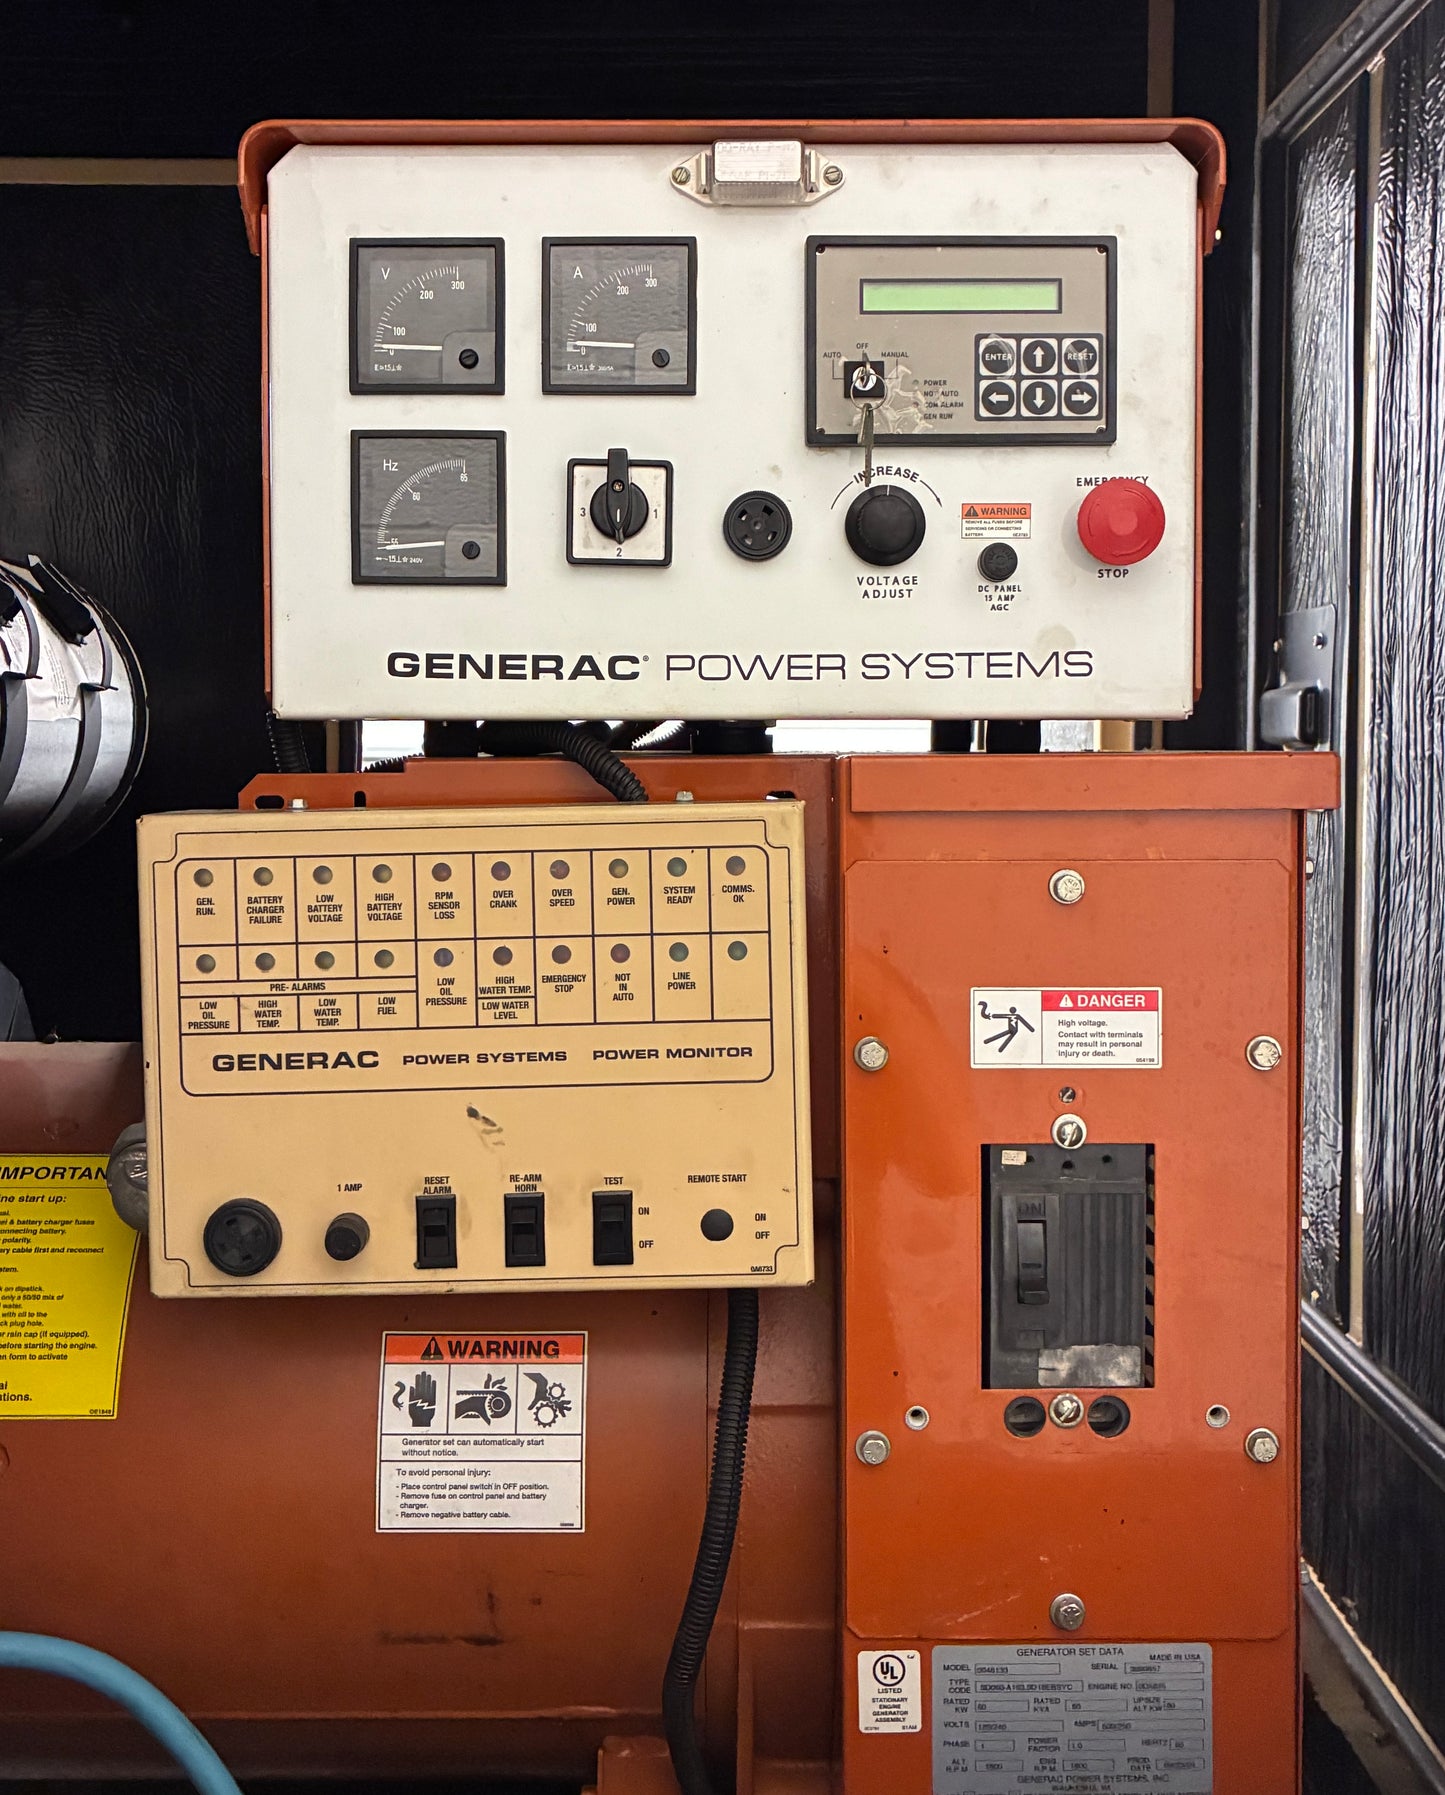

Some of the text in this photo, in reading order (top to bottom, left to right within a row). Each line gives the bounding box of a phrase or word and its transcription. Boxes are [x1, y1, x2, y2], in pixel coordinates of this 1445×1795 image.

[382, 268, 390, 280] V
[574, 266, 583, 278] A
[451, 281, 465, 290] 300
[645, 279, 658, 287] 300
[617, 286, 629, 295] 200
[420, 291, 434, 299] 200
[394, 327, 406, 336] 100
[586, 323, 597, 332] 100
[581, 347, 585, 355] 0
[384, 459, 398, 471] Hz
[461, 473, 468, 482] 65
[854, 466, 919, 484] INCREASE
[1077, 476, 1149, 486] EMERY
[413, 492, 421, 501] 60
[580, 508, 586, 517] 3
[654, 509, 658, 518] 1
[617, 548, 622, 557] 2
[1098, 569, 1129, 578] STOP
[857, 576, 918, 586] VOLTAGE
[862, 589, 913, 599] ADJUST
[666, 653, 846, 680] POWER
[861, 650, 1094, 680] SYSTEMS
[552, 889, 573, 897] OVER
[612, 888, 630, 896] GEN.
[664, 886, 695, 894] SYSTEM
[722, 885, 755, 893] COMMS.
[375, 893, 394, 901] HIGH
[435, 892, 453, 900] RPM
[493, 890, 514, 898] OVER
[197, 898, 215, 906] GEN.
[248, 896, 283, 904] BATTERY
[316, 895, 334, 903] LOW
[550, 899, 575, 907] SPEED
[607, 897, 636, 906] POWER
[667, 896, 693, 904] READY
[733, 895, 744, 903] OK
[367, 903, 403, 912] BATTERY
[428, 901, 460, 910] SENSOR
[490, 900, 517, 908] CRANK
[196, 908, 215, 916] RUN.
[247, 906, 284, 914] CHARGER
[308, 904, 343, 913] BATTERY
[249, 916, 282, 924] FAILURE
[308, 914, 343, 923] VOLTAGE
[368, 913, 403, 921] VOLTAGE
[496, 976, 515, 984] HIGH
[542, 975, 587, 983] EMERGENCY
[673, 972, 691, 980] LINE
[437, 978, 455, 986] LOW
[668, 982, 696, 990] POWER
[292, 983, 326, 991] ALARMS
[479, 986, 532, 994] WATER TEMP.
[555, 985, 574, 993] STOP
[440, 988, 452, 996] OIL
[378, 997, 396, 1005] LOW
[613, 993, 634, 1001] AUTO
[1078, 995, 1145, 1007] DANGER
[259, 1000, 278, 1008] HIGH
[319, 999, 336, 1007] LOW
[426, 997, 467, 1006] PRESSURE
[482, 1001, 529, 1010] LOW WATER
[200, 1002, 217, 1010] LOW
[255, 1010, 282, 1018] WATER
[314, 1008, 342, 1016] WATER
[378, 1007, 397, 1015] FUEL
[202, 1012, 215, 1020] OIL
[494, 1012, 518, 1020] LEVEL
[188, 1021, 230, 1029] PRESSURE
[257, 1020, 280, 1028] TEMP.
[316, 1018, 339, 1026] TEMP.
[593, 1046, 753, 1060] POWER MONITOR
[1058, 1050, 1080, 1058] injury
[213, 1051, 567, 1072] GENERAC POWER SYSTEMS
[425, 1176, 450, 1185] RESET
[510, 1174, 542, 1183] RE-ARM
[604, 1177, 623, 1185] TEST
[688, 1174, 747, 1183] REMOTE START
[337, 1184, 362, 1192] 1 AMP
[423, 1187, 452, 1195] ALARM
[515, 1184, 537, 1192] HORN
[48, 1195, 66, 1204] up:
[639, 1207, 650, 1215] ON
[639, 1240, 654, 1248] OFF
[448, 1340, 560, 1359] WARNING
[473, 1439, 525, 1447] automatically
[432, 1469, 466, 1478] personal
[468, 1469, 491, 1478] injury:
[1016, 1647, 1124, 1657] GENERATOR SET DATA
